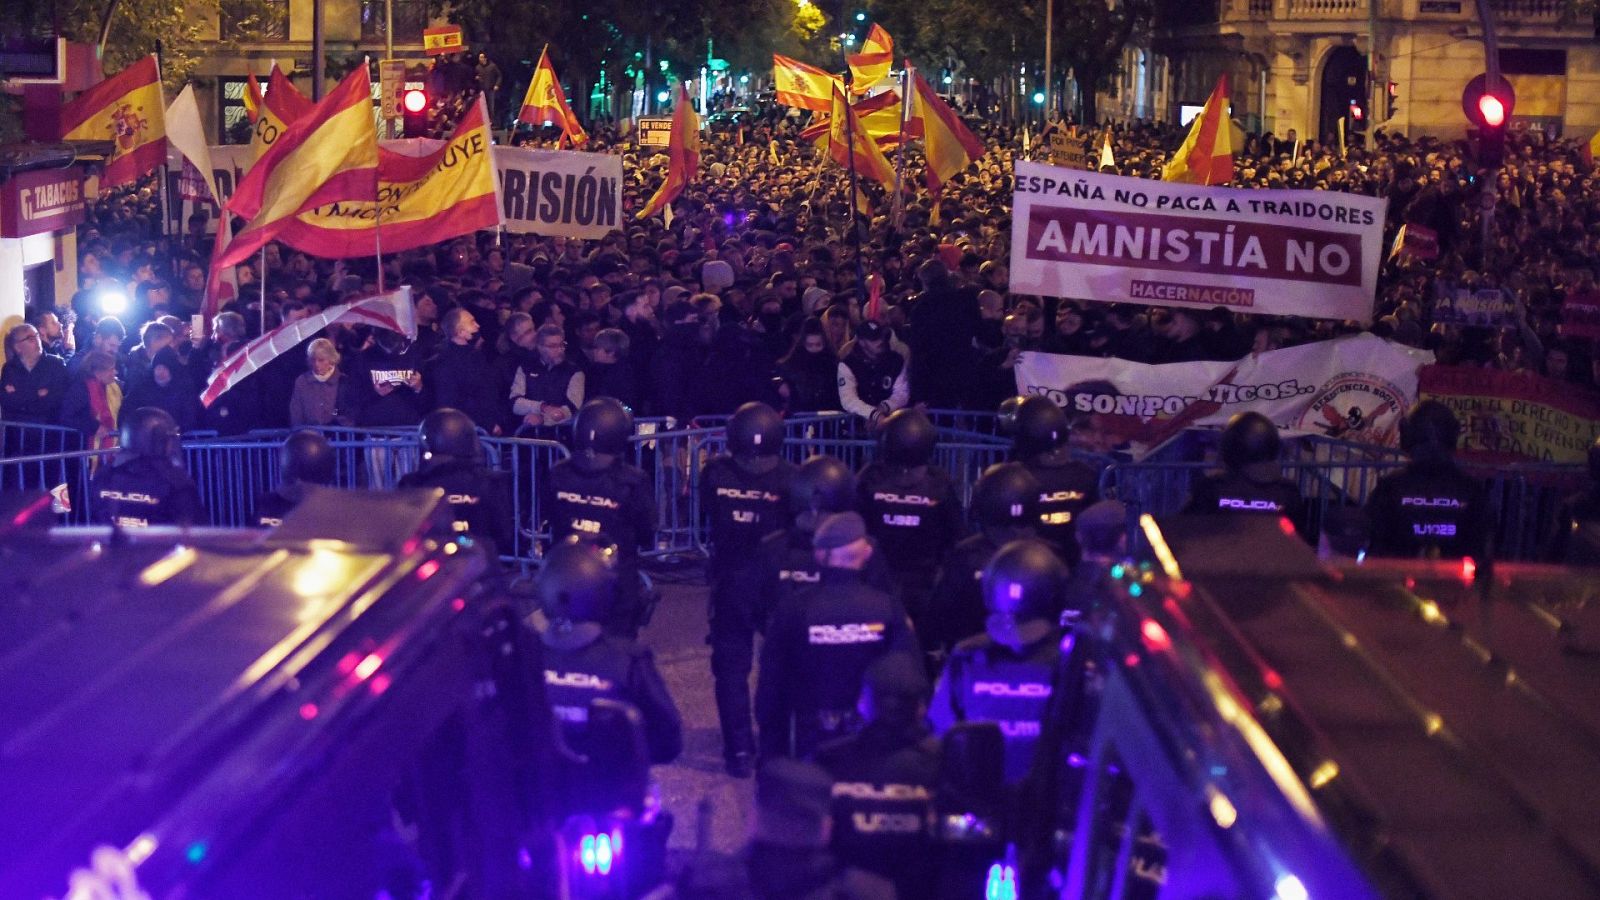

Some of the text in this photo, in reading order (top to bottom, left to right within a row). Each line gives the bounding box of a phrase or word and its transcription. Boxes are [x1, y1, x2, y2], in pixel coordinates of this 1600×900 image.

[641, 121, 672, 130] SE VENDE
[34, 180, 79, 209] TABACOS
[498, 166, 617, 226] RISIÓN
[1014, 175, 1374, 226] ESPAÑA NO PAGA A TRAIDORES
[1036, 219, 1351, 276] AMNISTÍA NO
[1073, 392, 1139, 416] SON
[100, 490, 151, 503] POLICIA
[874, 492, 930, 504] POLICIA
[1219, 498, 1276, 510] POLICIA
[1402, 497, 1460, 508] POLICIA
[831, 781, 929, 800] POLICIA
